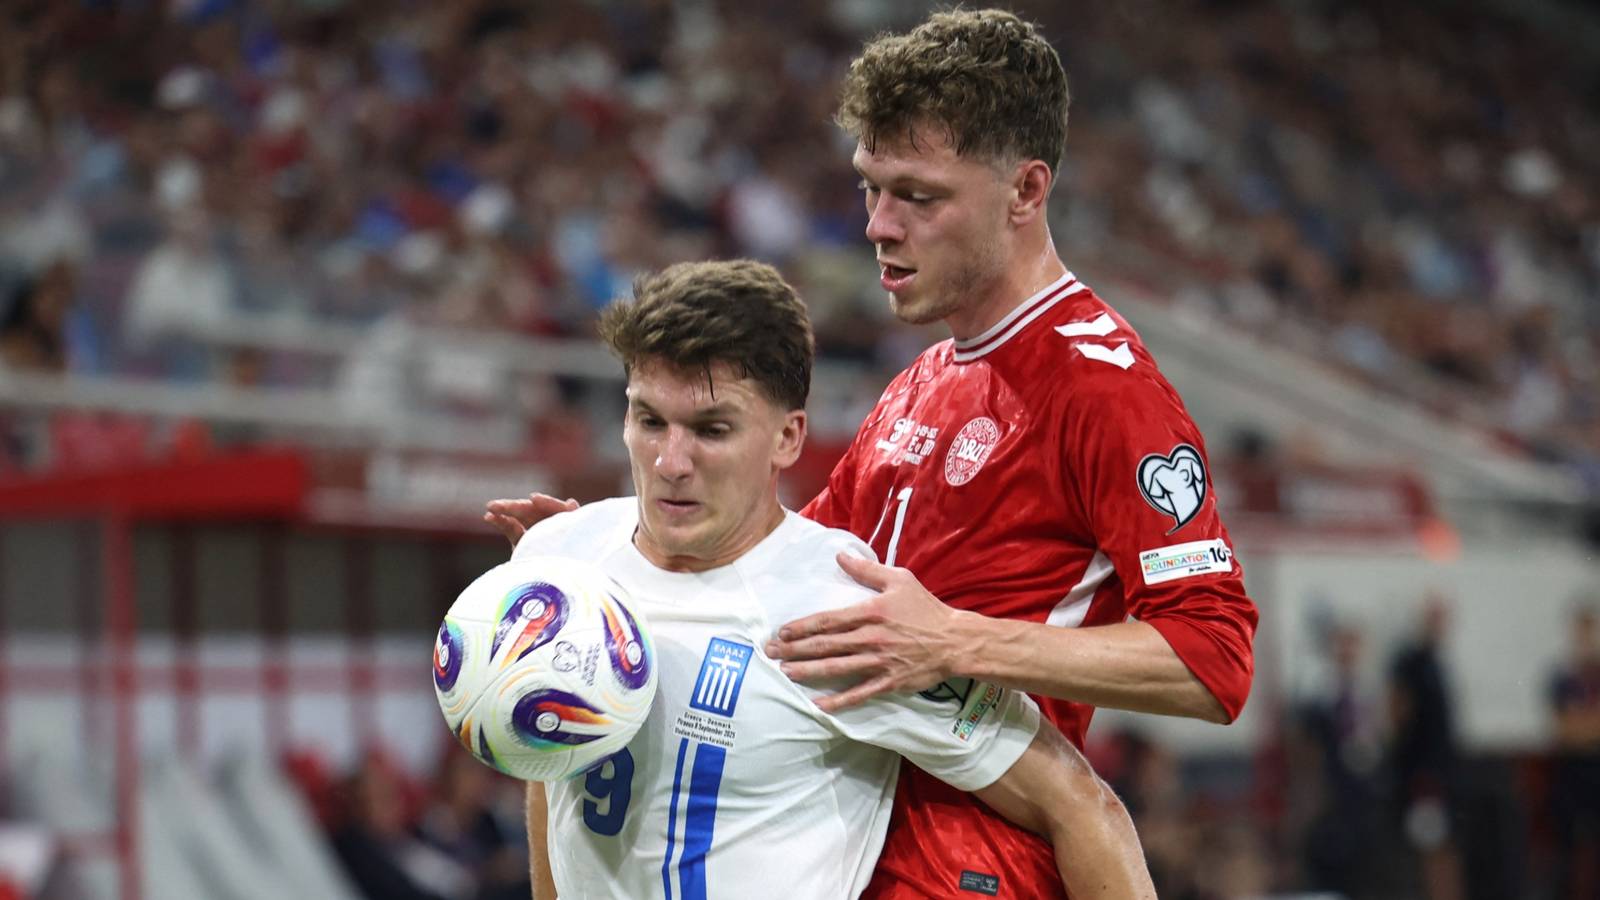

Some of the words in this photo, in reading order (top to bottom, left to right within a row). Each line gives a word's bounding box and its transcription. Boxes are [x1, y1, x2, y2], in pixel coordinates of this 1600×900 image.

[956, 438, 987, 462] DBU
[1144, 552, 1209, 572] FOUNDATION
[677, 718, 694, 729] Piraeus
[698, 723, 723, 735] September
[723, 730, 736, 739] 2025
[684, 712, 702, 722] Greece
[707, 718, 732, 729] Denmark
[674, 727, 691, 736] Stadium
[582, 746, 634, 836] 9
